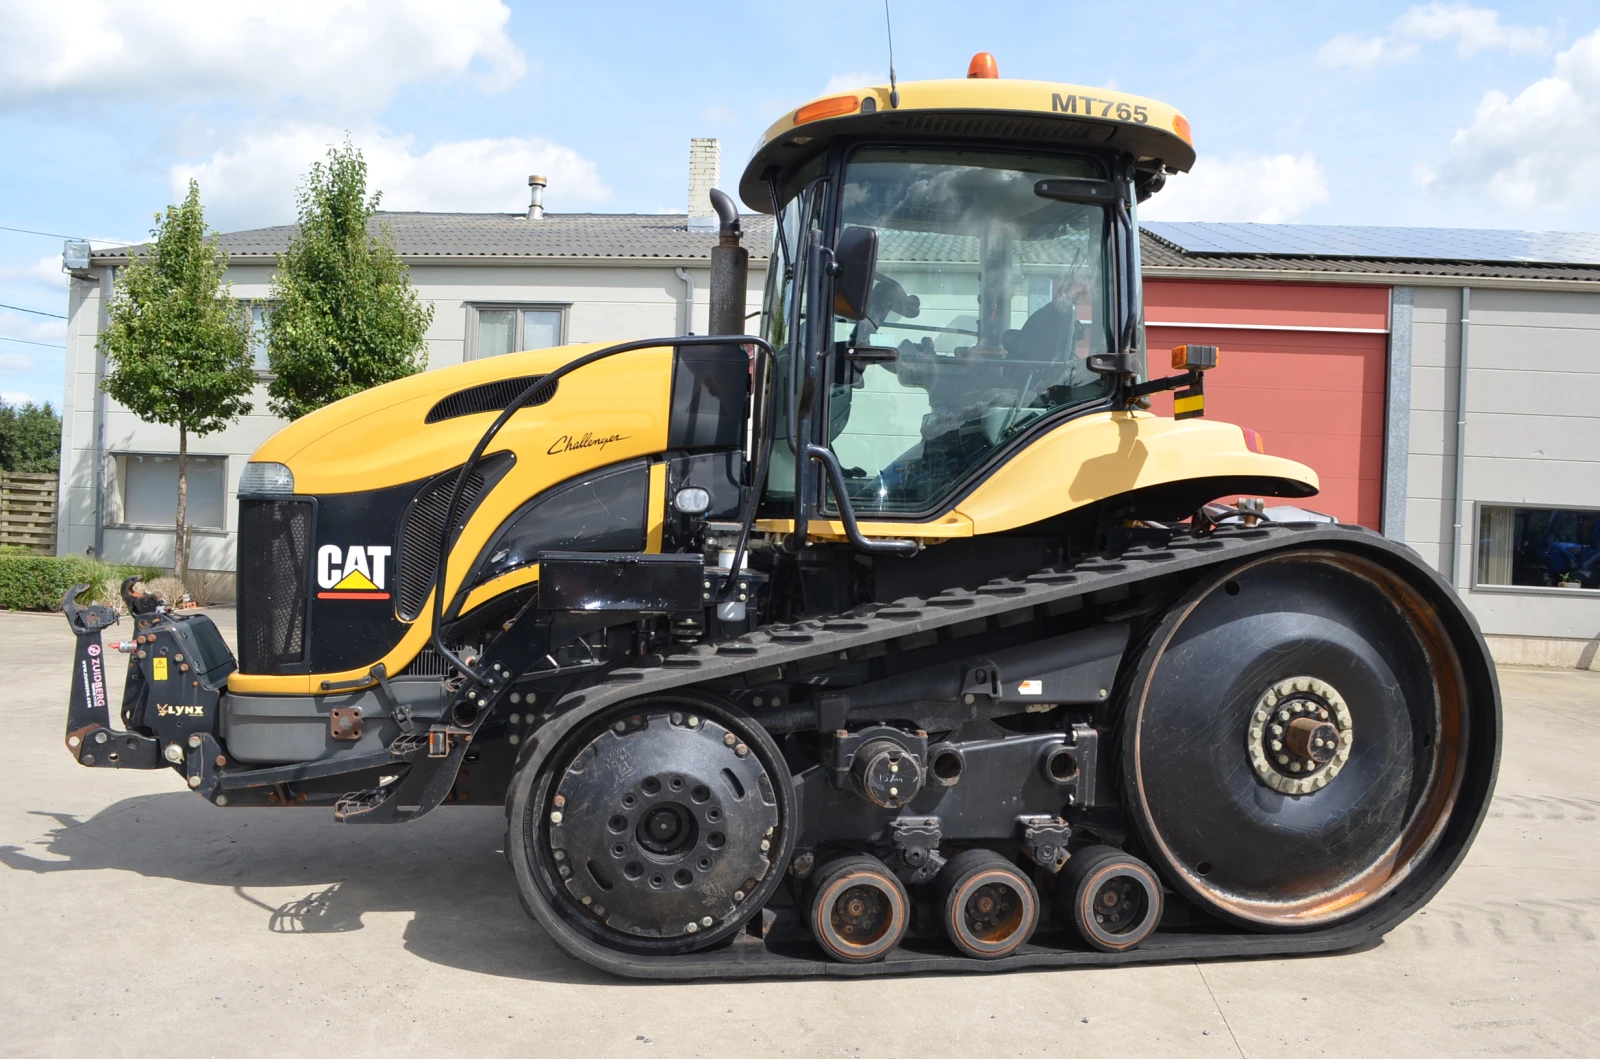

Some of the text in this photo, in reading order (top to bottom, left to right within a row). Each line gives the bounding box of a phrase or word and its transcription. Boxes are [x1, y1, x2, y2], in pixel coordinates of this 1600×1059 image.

[1051, 93, 1149, 124] MT765
[546, 432, 632, 455] Challenger
[317, 544, 391, 590] CAT
[91, 657, 105, 707] ZUIDBERG
